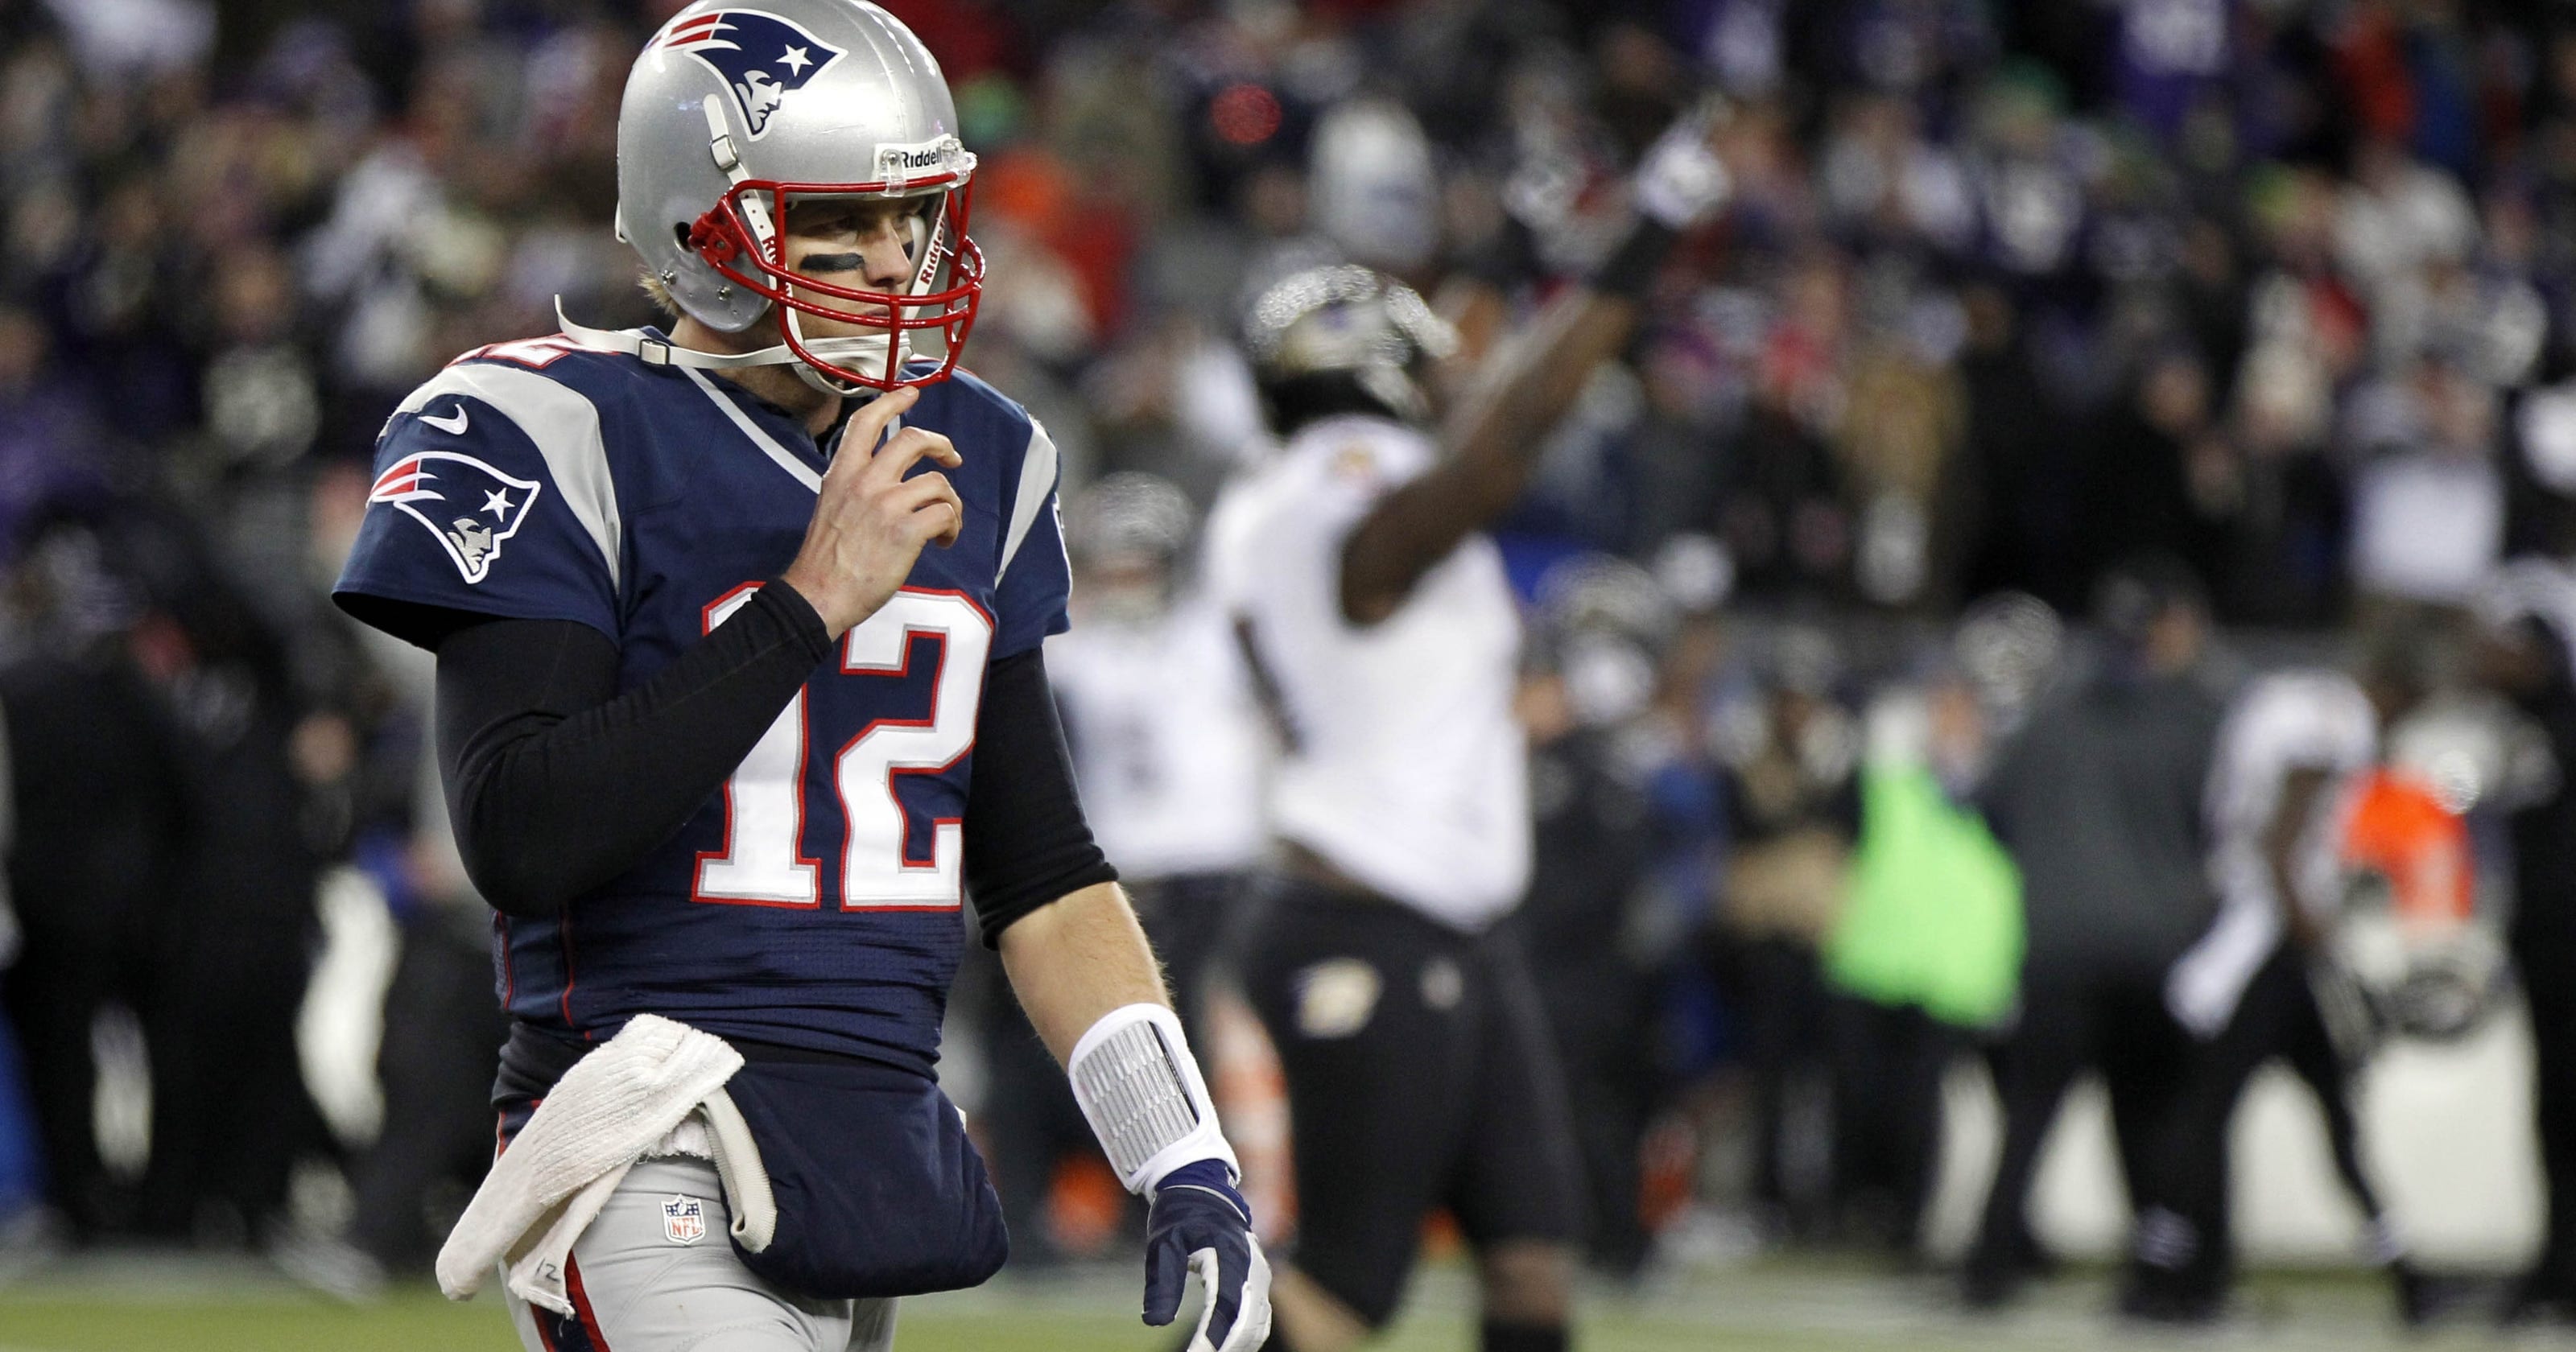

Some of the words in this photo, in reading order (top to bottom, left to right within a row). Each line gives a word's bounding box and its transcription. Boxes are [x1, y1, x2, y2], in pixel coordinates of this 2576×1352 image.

[901, 146, 942, 168] Riddell
[691, 580, 995, 913] 12
[671, 1217, 700, 1237] NFL
[535, 1257, 561, 1284] 12
